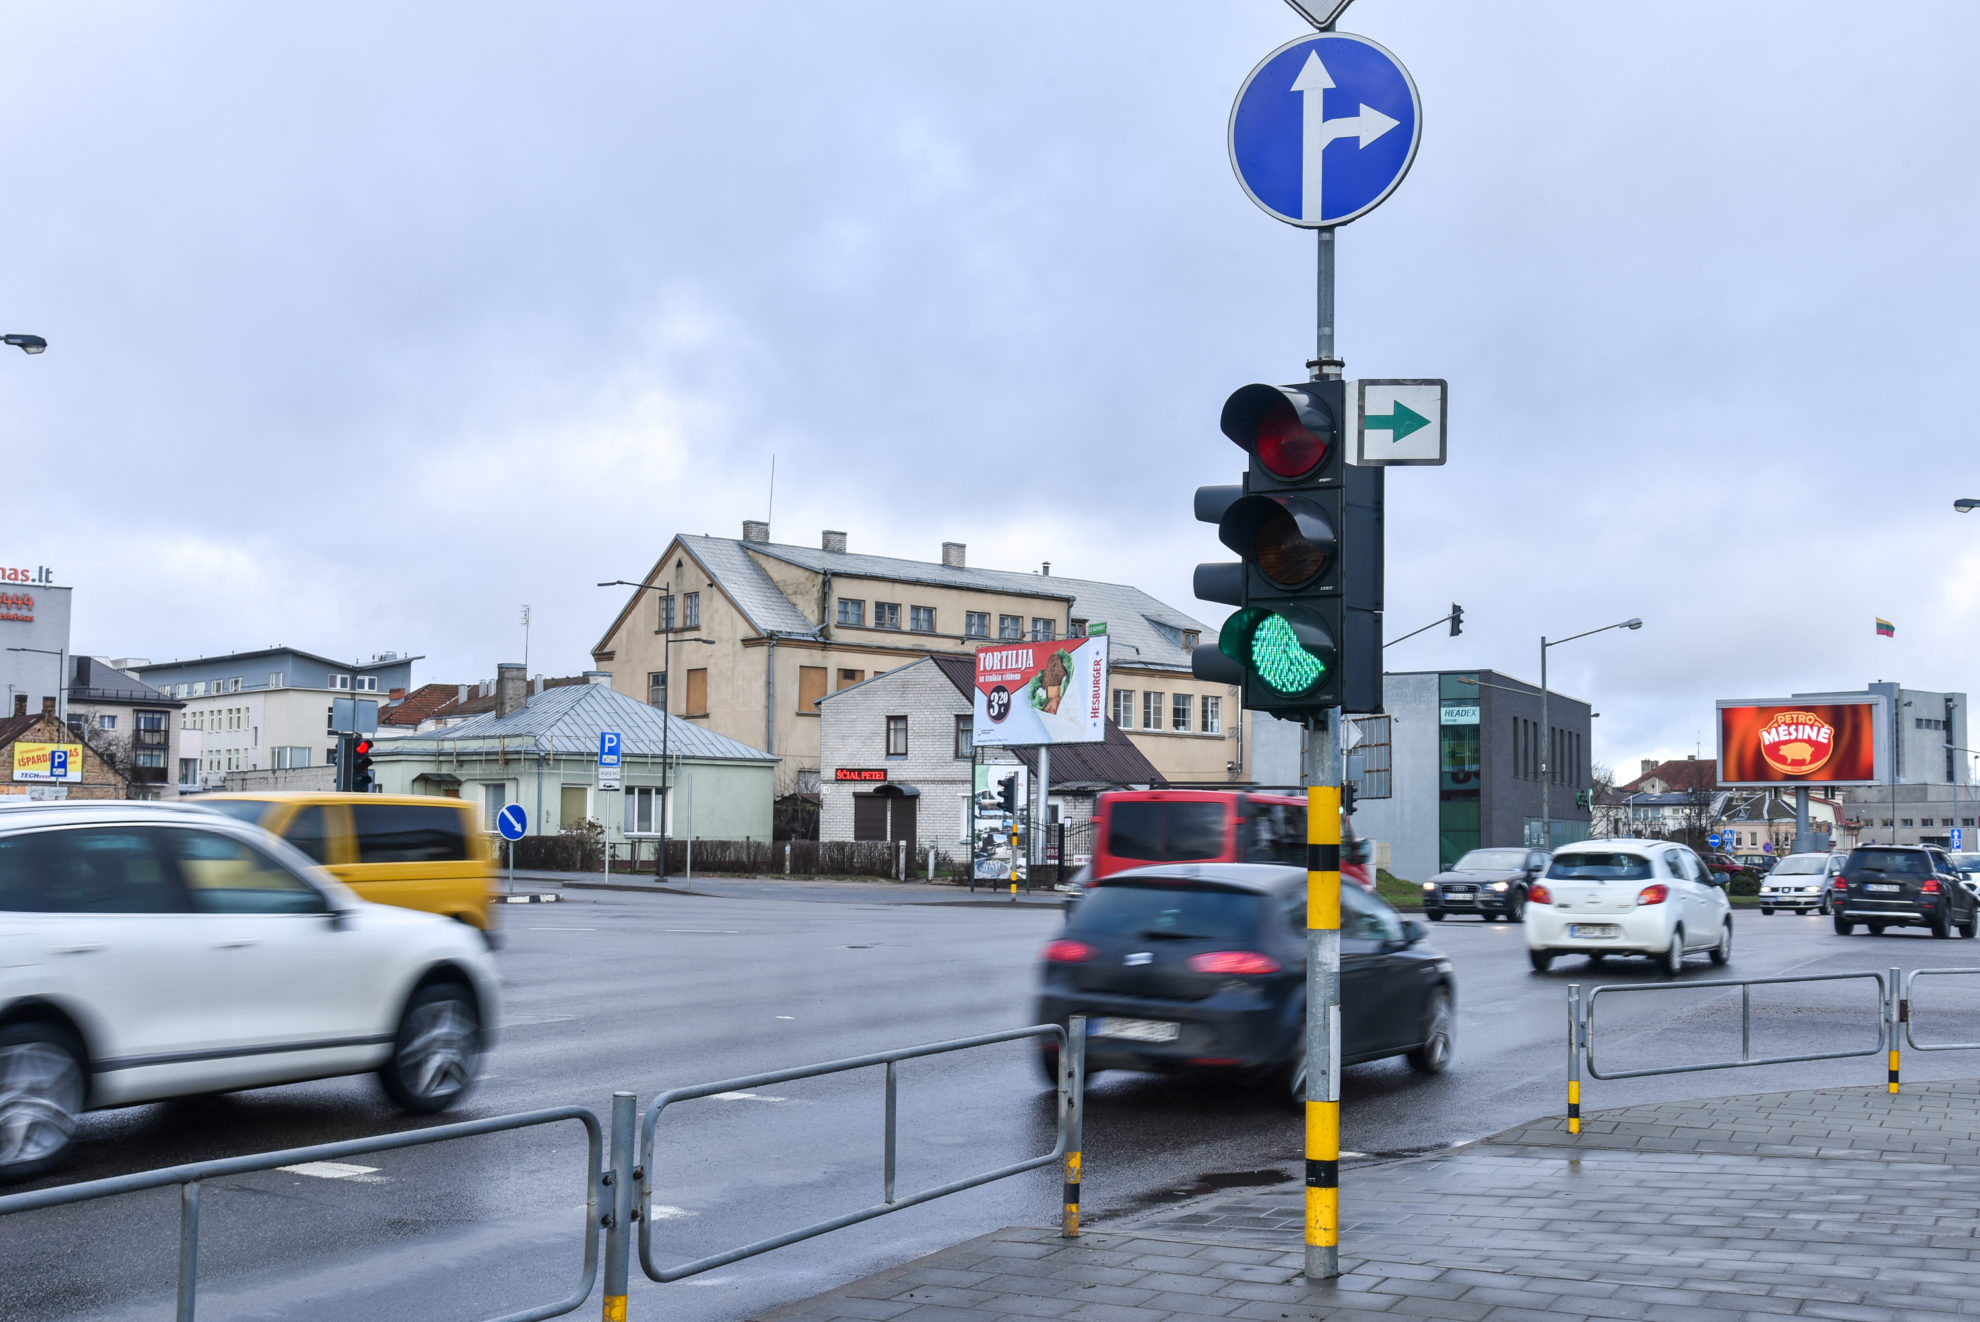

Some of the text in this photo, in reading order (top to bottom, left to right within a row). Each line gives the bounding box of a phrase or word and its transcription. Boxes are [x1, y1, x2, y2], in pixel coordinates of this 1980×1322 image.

[0, 593, 34, 611] 444
[979, 649, 1034, 670] TORTILIJA
[1090, 658, 1102, 719] HESBURGER
[1444, 709, 1477, 717] HEADEX
[1777, 714, 1815, 724] PETRO
[604, 734, 617, 753] P
[1761, 724, 1831, 746] MĖSINĖ
[18, 748, 79, 767] IŠPARDAS
[54, 752, 65, 767] P
[1953, 841, 1960, 849] P
